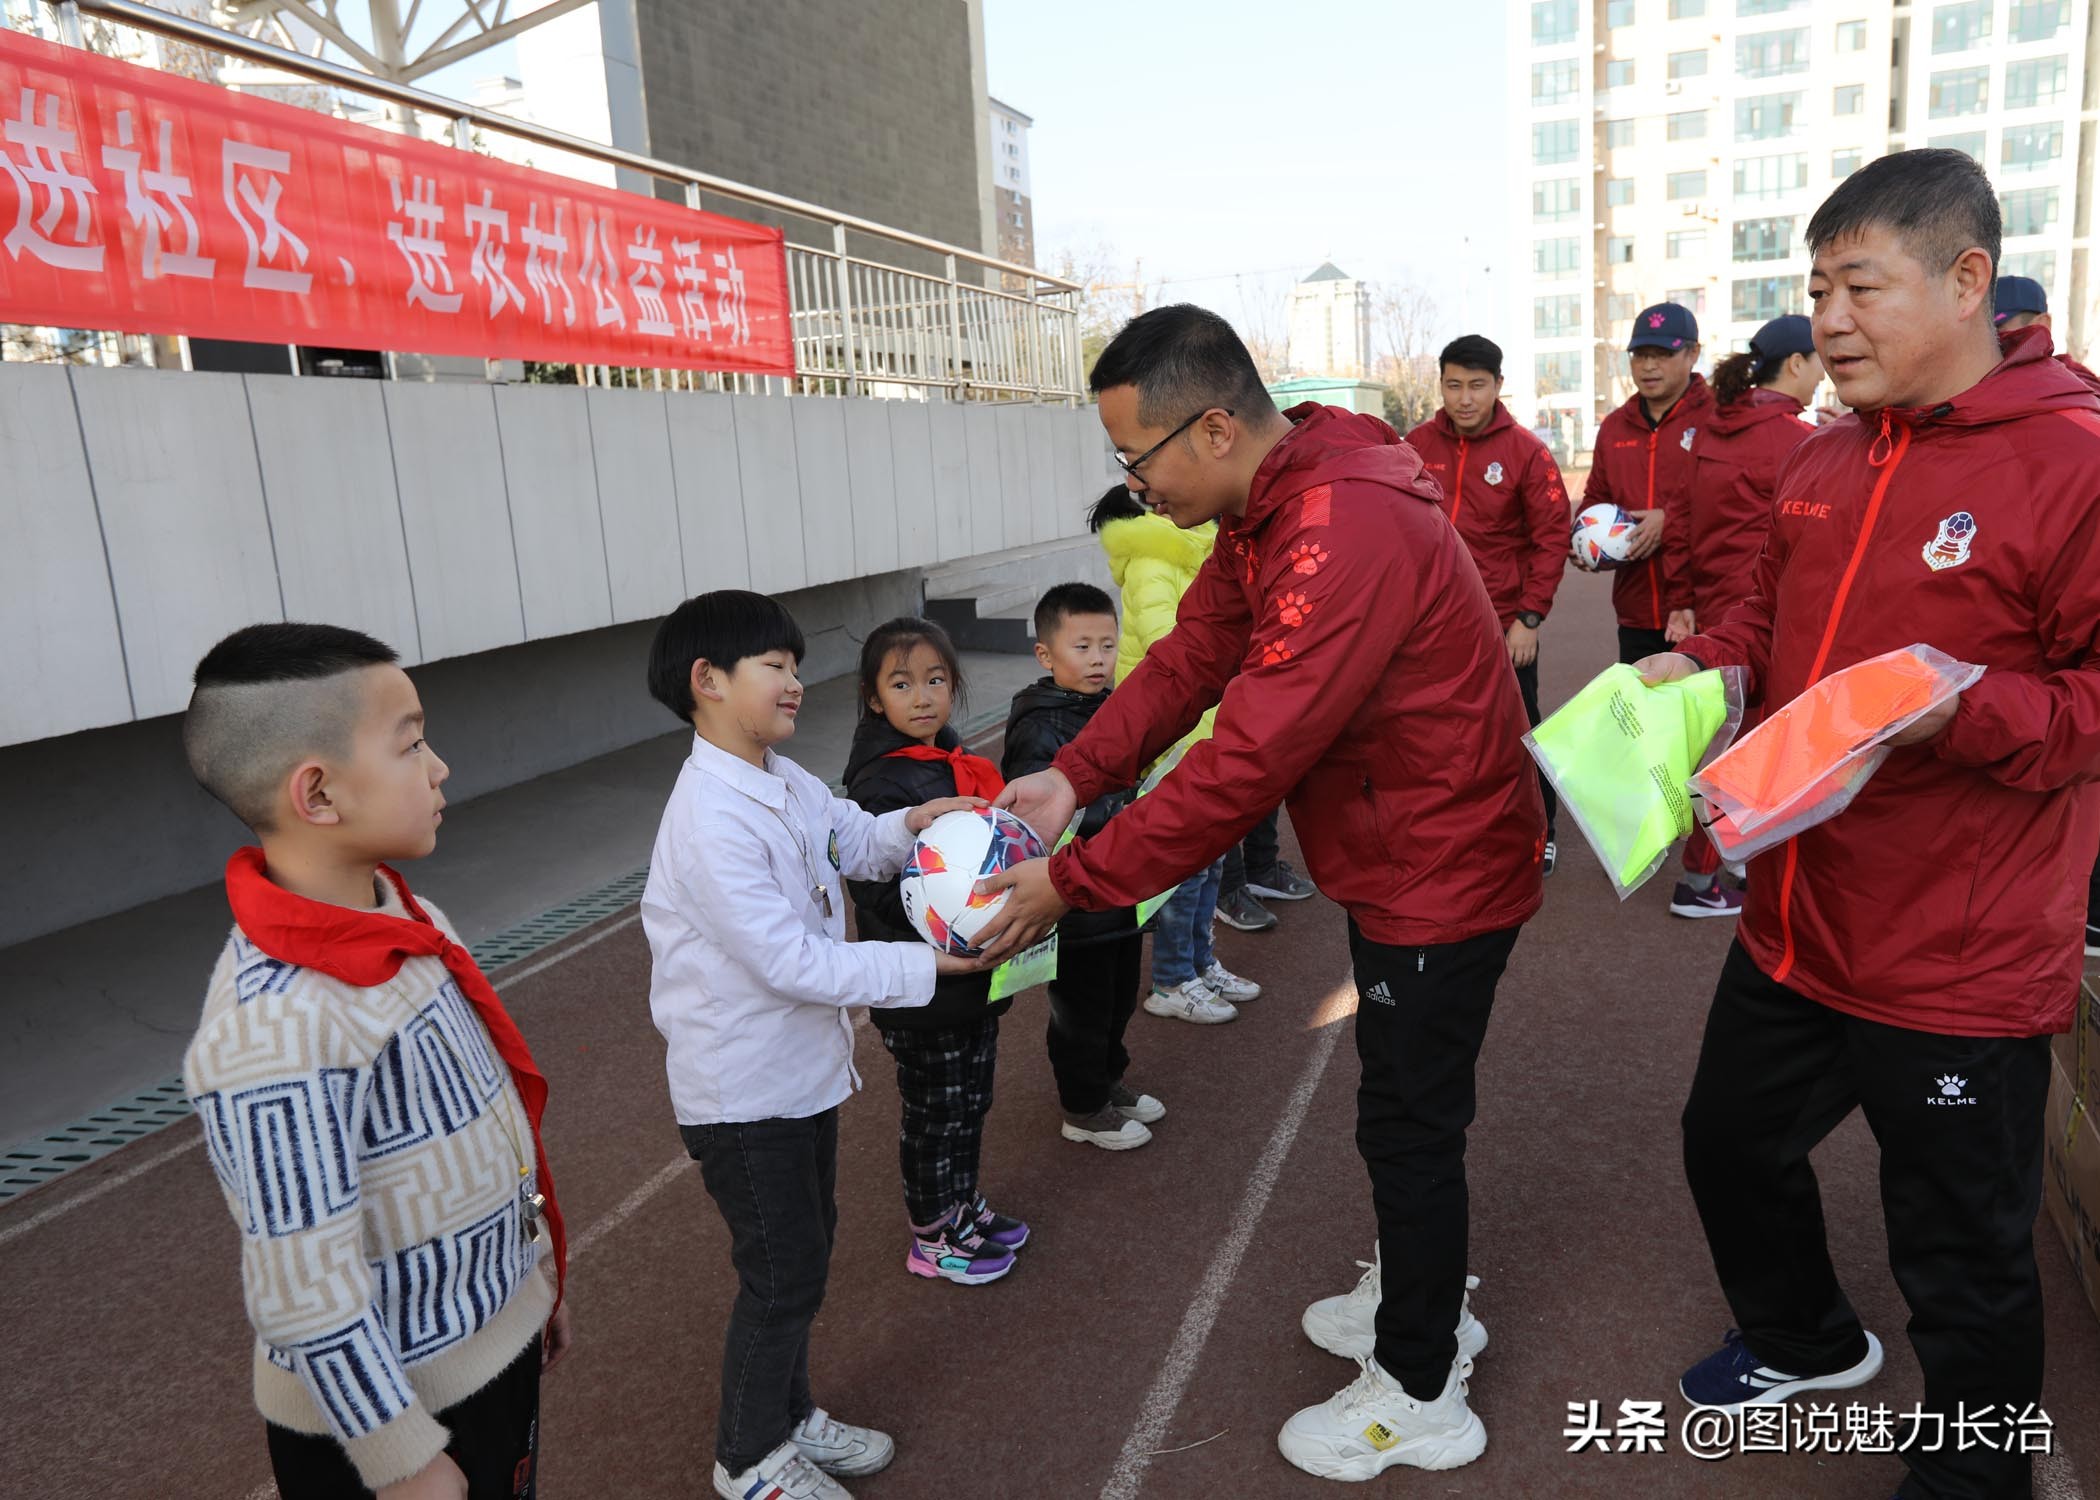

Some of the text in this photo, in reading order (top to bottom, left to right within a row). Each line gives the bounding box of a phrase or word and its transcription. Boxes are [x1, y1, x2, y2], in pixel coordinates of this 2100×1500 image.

[1782, 500, 1832, 519] KELME
[1366, 991, 1396, 1007] adidas
[1927, 1097, 1977, 1105] KELME
